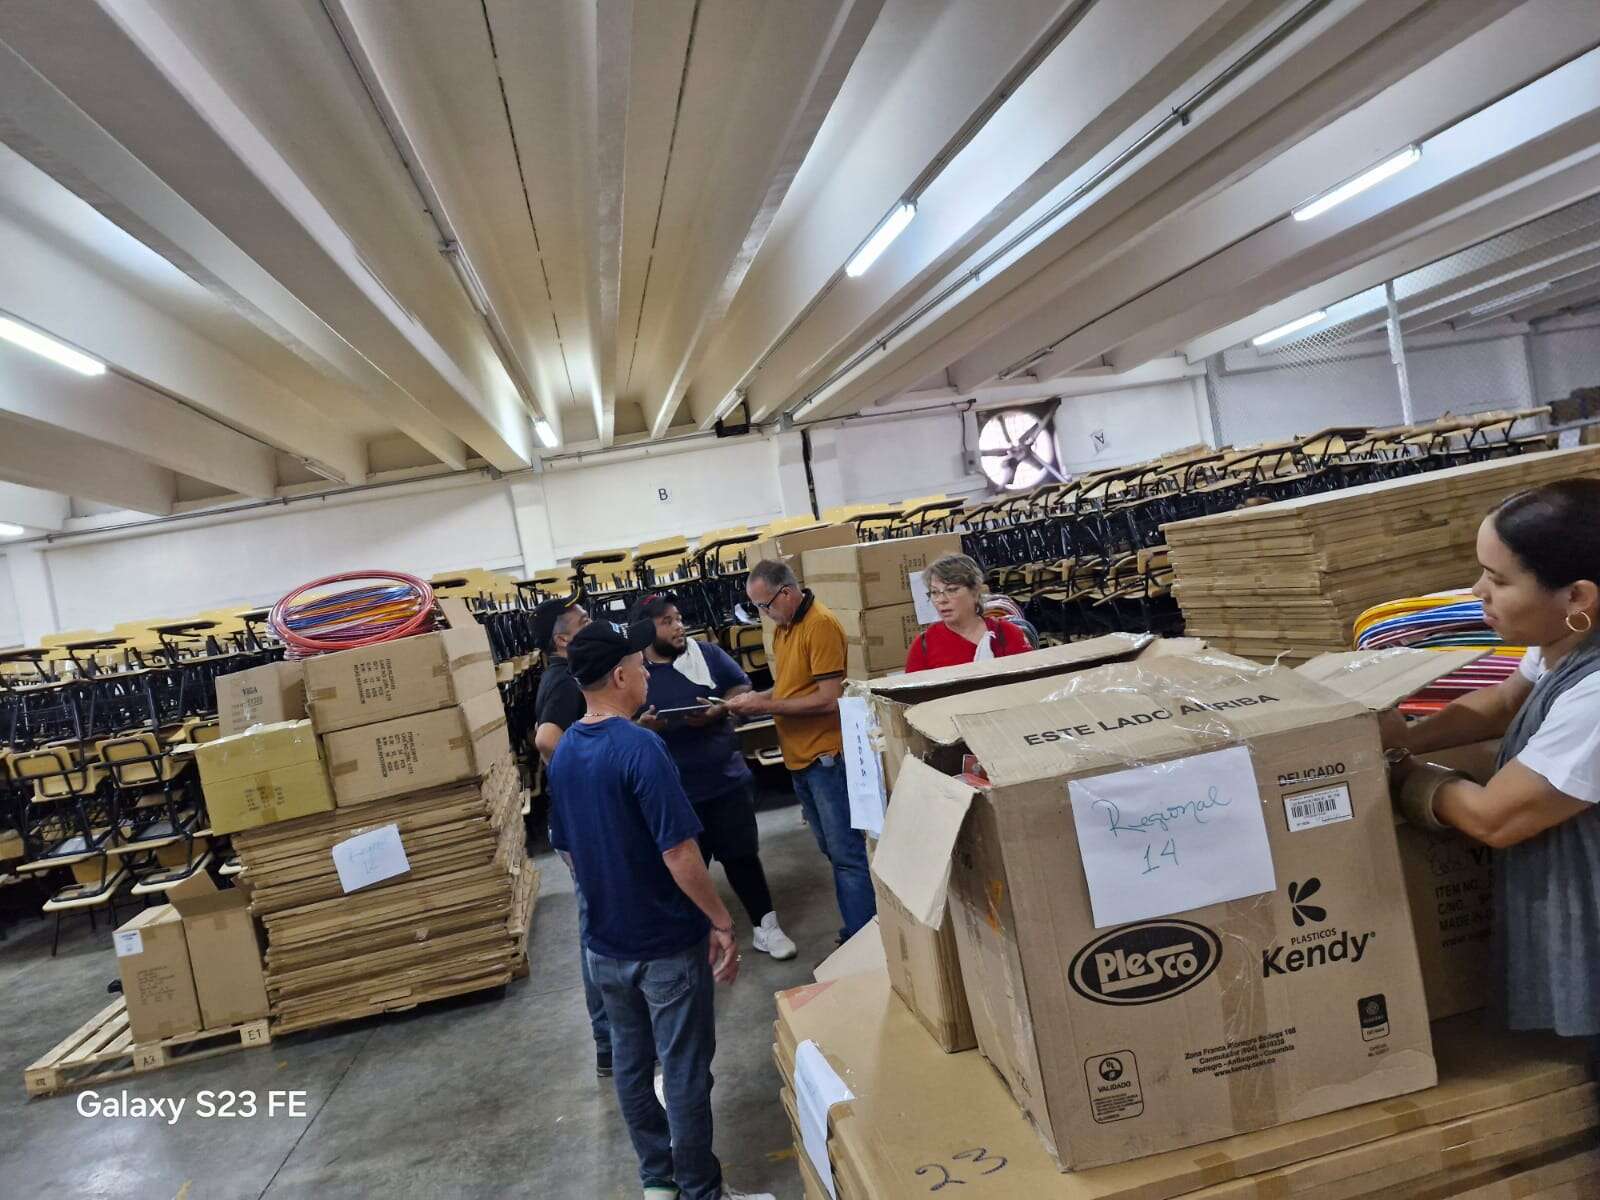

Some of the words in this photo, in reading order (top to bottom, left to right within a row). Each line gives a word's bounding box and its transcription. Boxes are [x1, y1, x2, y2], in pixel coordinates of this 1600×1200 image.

[658, 488, 668, 501] B
[1024, 724, 1095, 746] ESTE
[1097, 709, 1173, 731] LADO
[1278, 762, 1345, 787] DELICADO
[1091, 785, 1232, 838] Regional
[1142, 838, 1179, 875] 14
[1435, 883, 1461, 899] ITEM
[1439, 911, 1472, 931] MADE
[1290, 928, 1337, 946] PLASTICOS
[248, 1029, 261, 1040] E1
[1184, 1050, 1202, 1060] Zona
[1203, 1045, 1226, 1055] Franca
[1227, 1038, 1257, 1049] Rionegro
[1192, 1062, 1222, 1074] Rionegro
[1228, 1053, 1259, 1065] Antioquia
[1263, 1044, 1295, 1056] Colombia
[1098, 1081, 1131, 1093] VALIDADO
[915, 1147, 1008, 1192] 23
